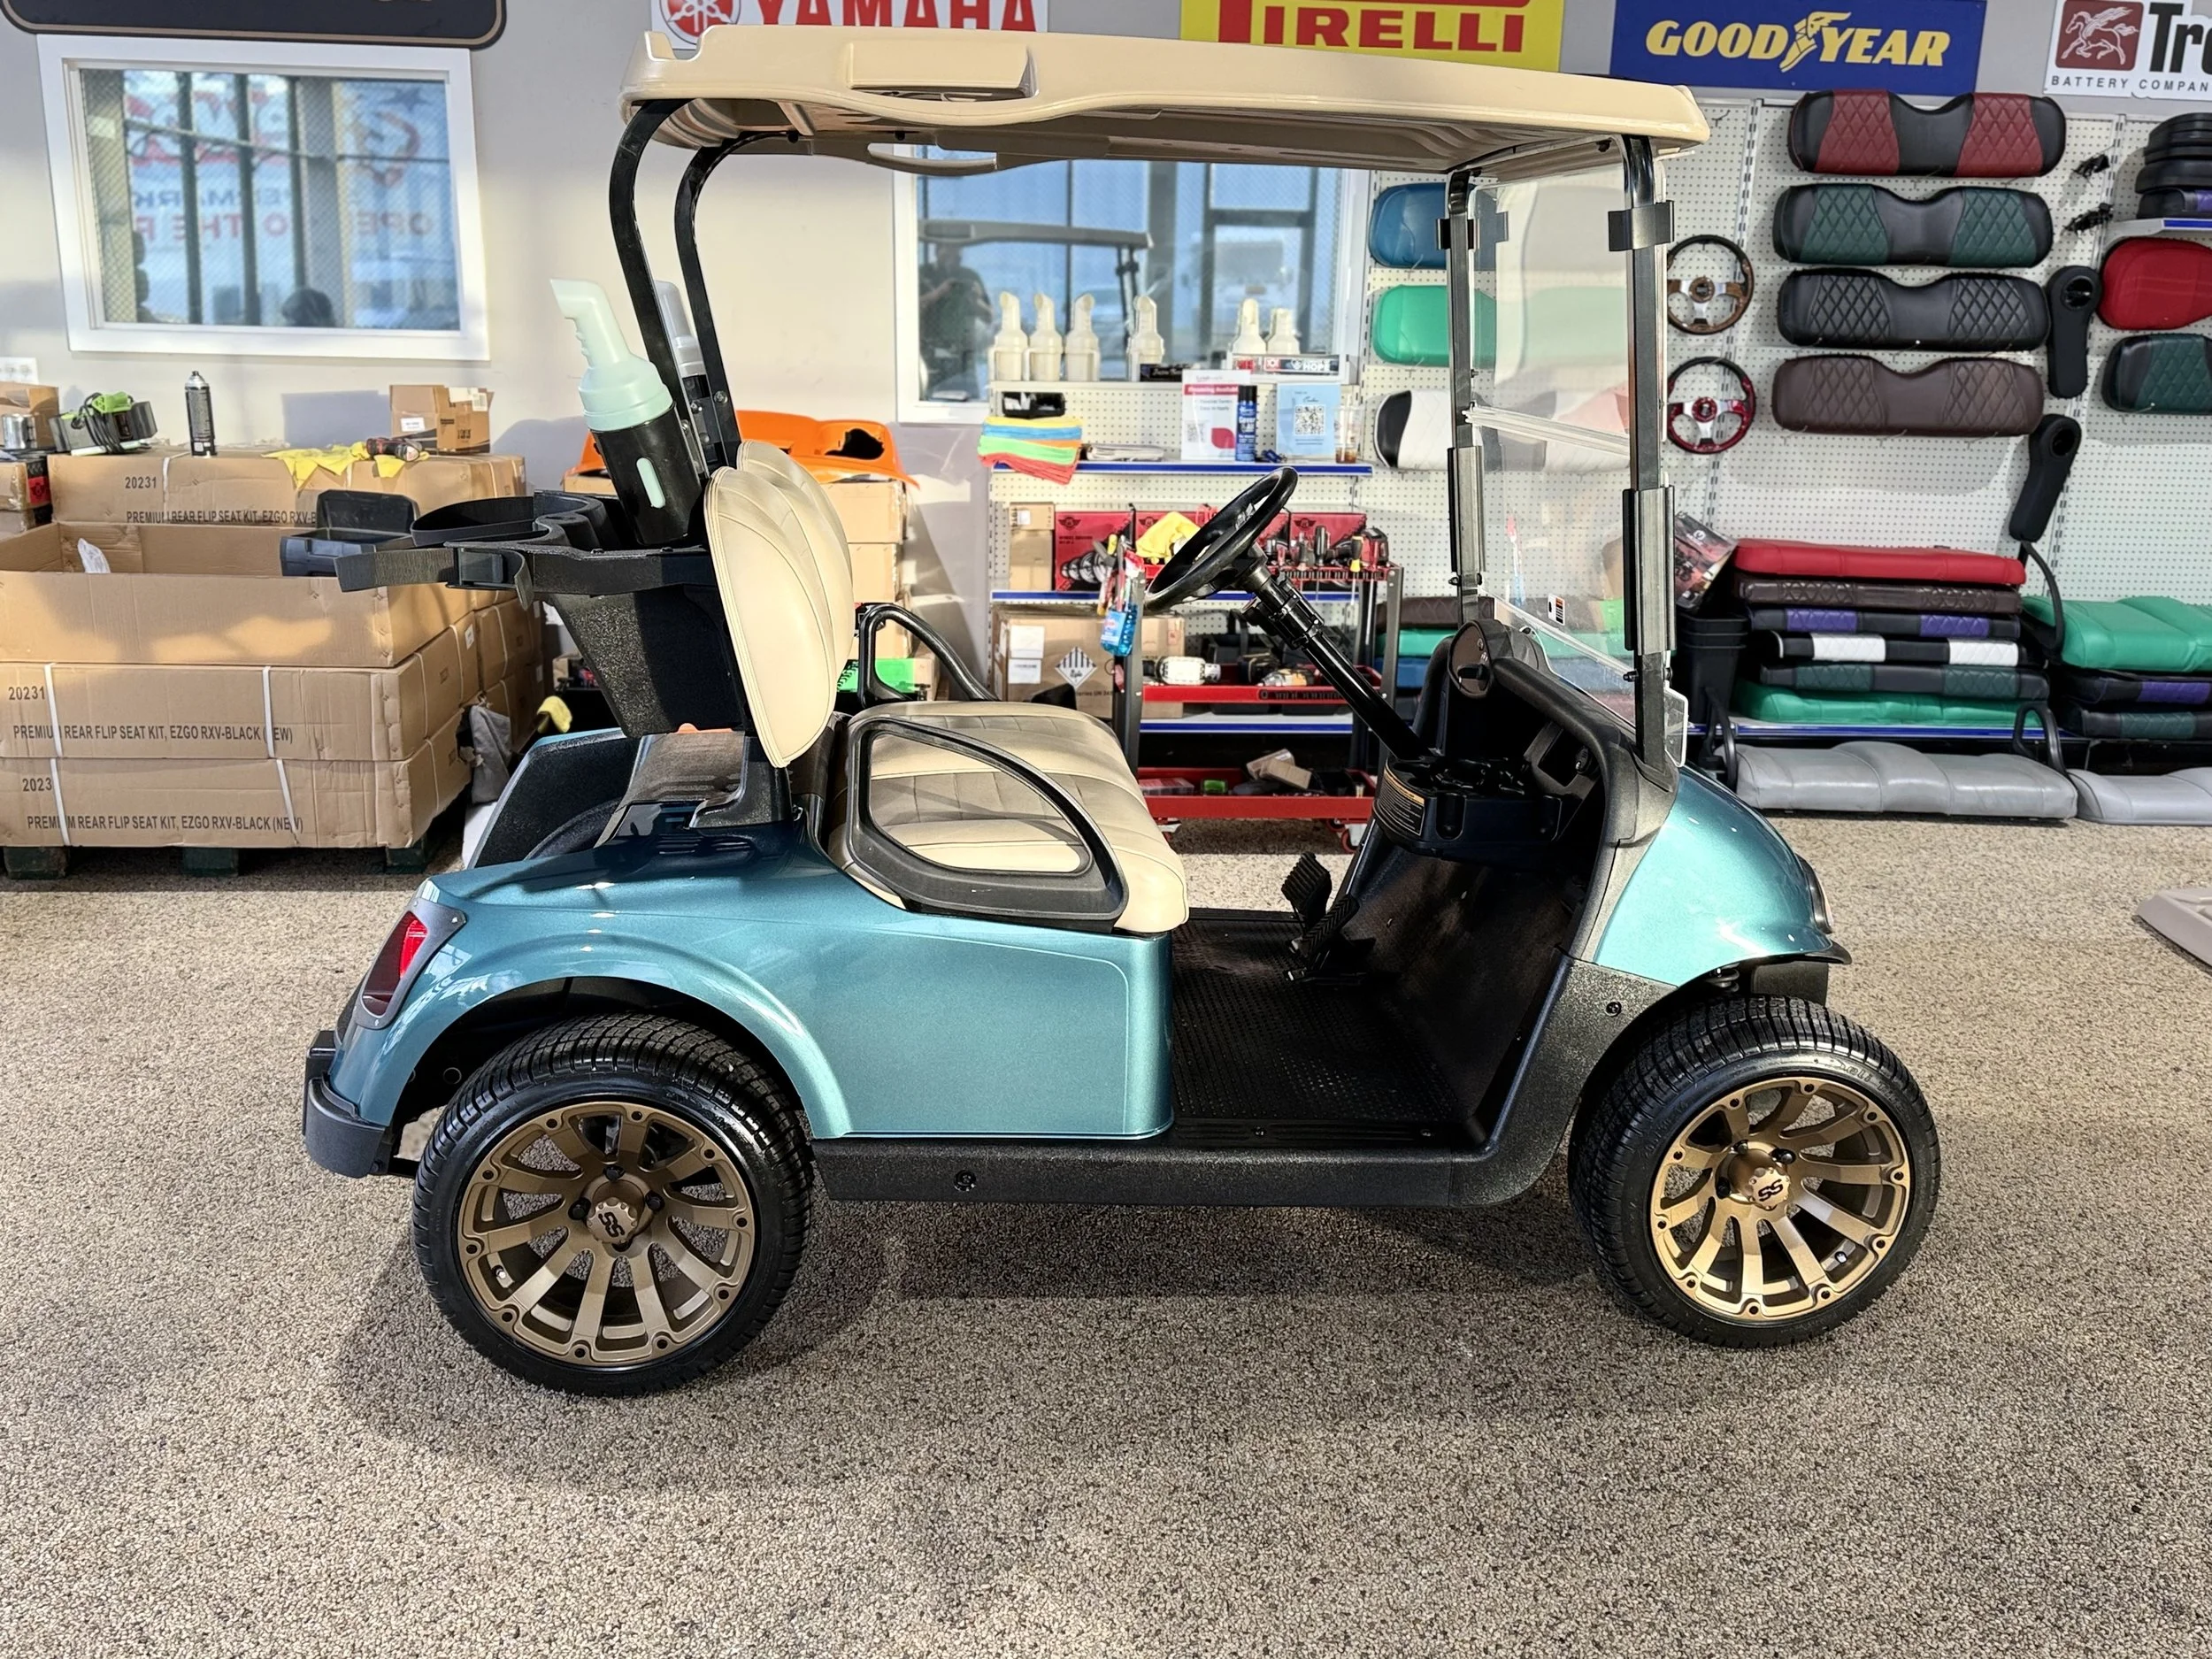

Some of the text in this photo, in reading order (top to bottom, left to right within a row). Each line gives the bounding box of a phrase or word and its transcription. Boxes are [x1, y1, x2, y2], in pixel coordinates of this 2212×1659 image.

[757, 0, 1036, 32] YAMAHA
[2051, 75, 2129, 89] BATTERY
[125, 476, 157, 489] 20231
[171, 511, 196, 523] REAR
[197, 511, 217, 523] FLIP
[219, 510, 242, 523] SEAT
[262, 511, 288, 524] EZGO
[8, 686, 45, 700] 20231
[13, 725, 293, 744] PREMIU REAR FLIP SEAT KIT, EZGO RXV-BLACK (EW)
[22, 777, 52, 792] 2023
[78, 816, 106, 829] REAR
[109, 815, 130, 829] FLIP
[132, 816, 158, 829] SEAT
[160, 816, 180, 831] KIT,
[181, 815, 210, 829] EZGO
[212, 816, 271, 830] RXV-BLACK
